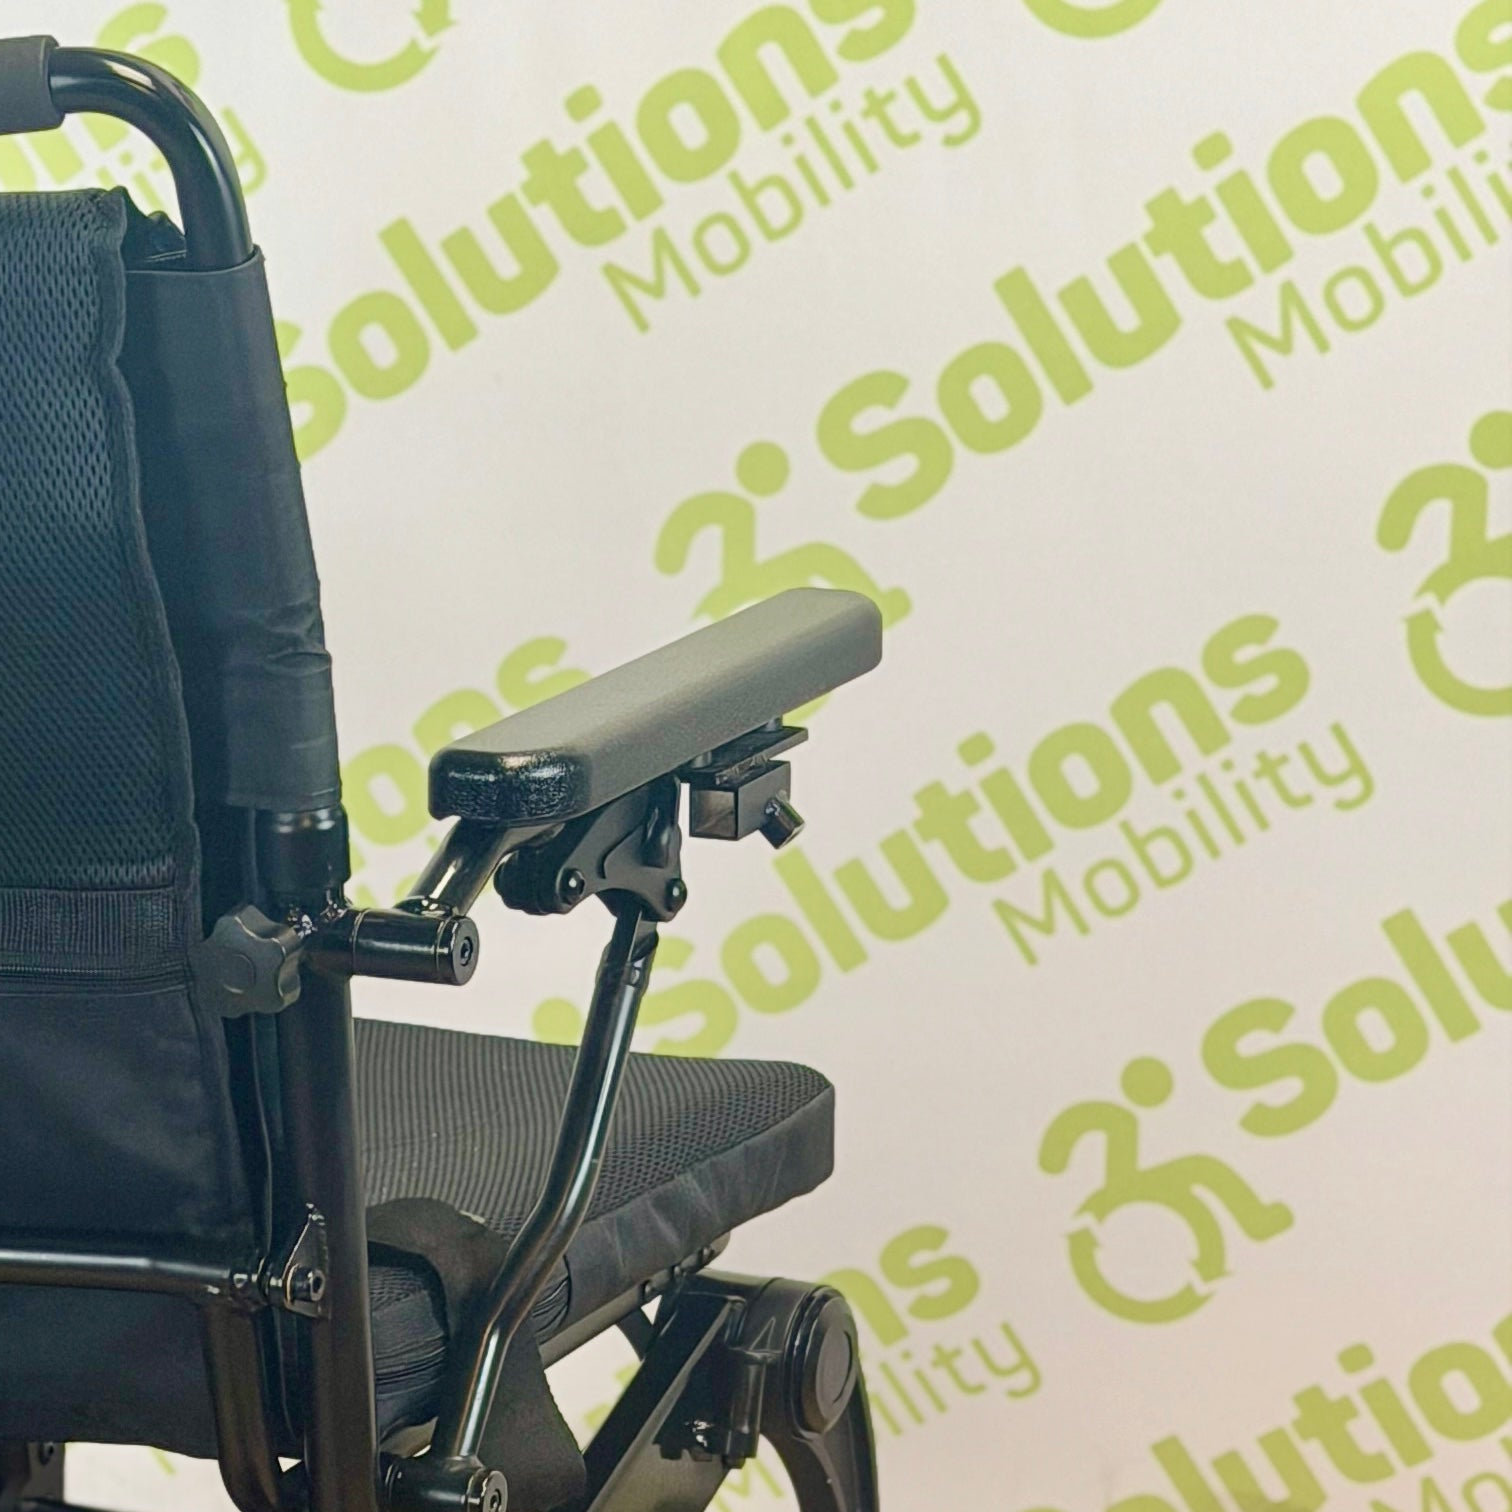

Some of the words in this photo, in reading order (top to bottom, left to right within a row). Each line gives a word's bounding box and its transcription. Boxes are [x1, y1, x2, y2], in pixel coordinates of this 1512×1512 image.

[600, 53, 982, 334] Mobility
[1225, 138, 1512, 391] Mobili
[991, 722, 1376, 968] Mobility
